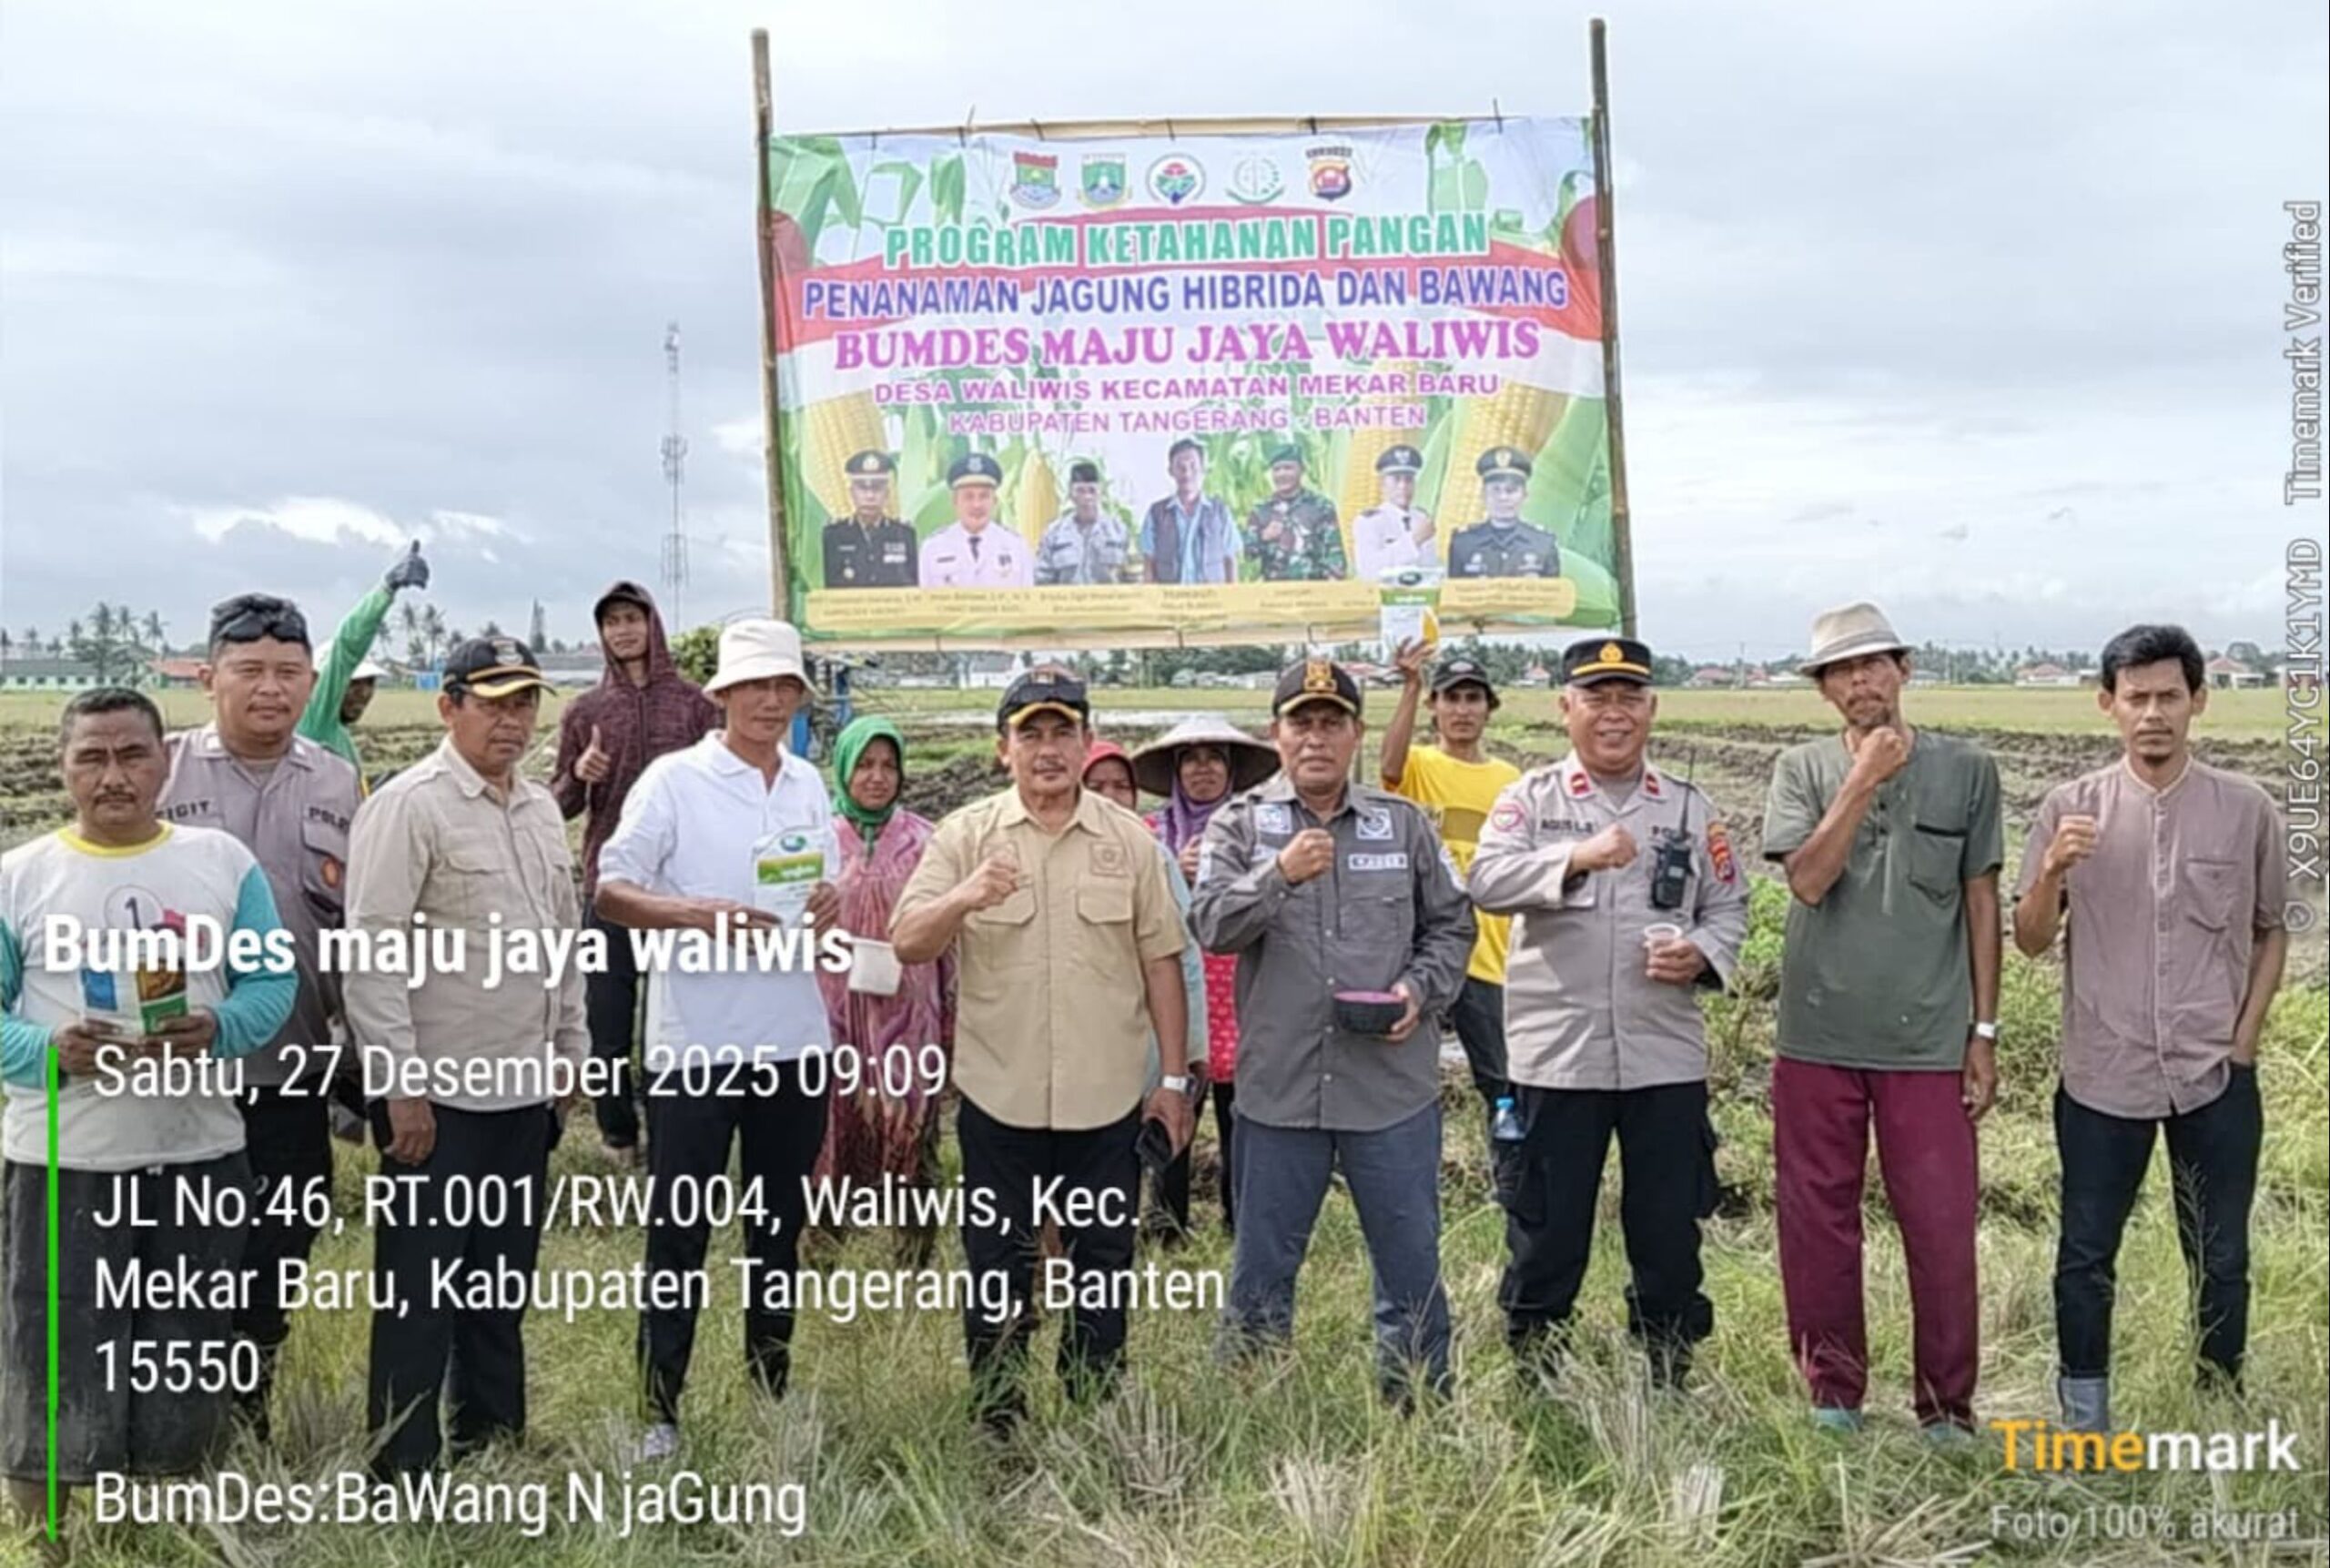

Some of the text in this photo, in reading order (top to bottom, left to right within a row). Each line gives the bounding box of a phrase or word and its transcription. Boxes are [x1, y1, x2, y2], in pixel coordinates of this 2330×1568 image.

[886, 213, 1487, 267] PROGRAM KETAHANAN PANGAN
[804, 267, 1566, 319] PENANAMAN JAGUNG HIBRIDA DAN BAWANG
[834, 319, 1541, 369] BUMDES MAJU JAYA WALIWIS
[875, 373, 1499, 403] DESA WALIWIS KECAMATAN MEKAR BARU
[948, 411, 1109, 433] KABUPATEN
[1120, 408, 1288, 431] TANGERANG
[1314, 405, 1425, 428] BANTEN
